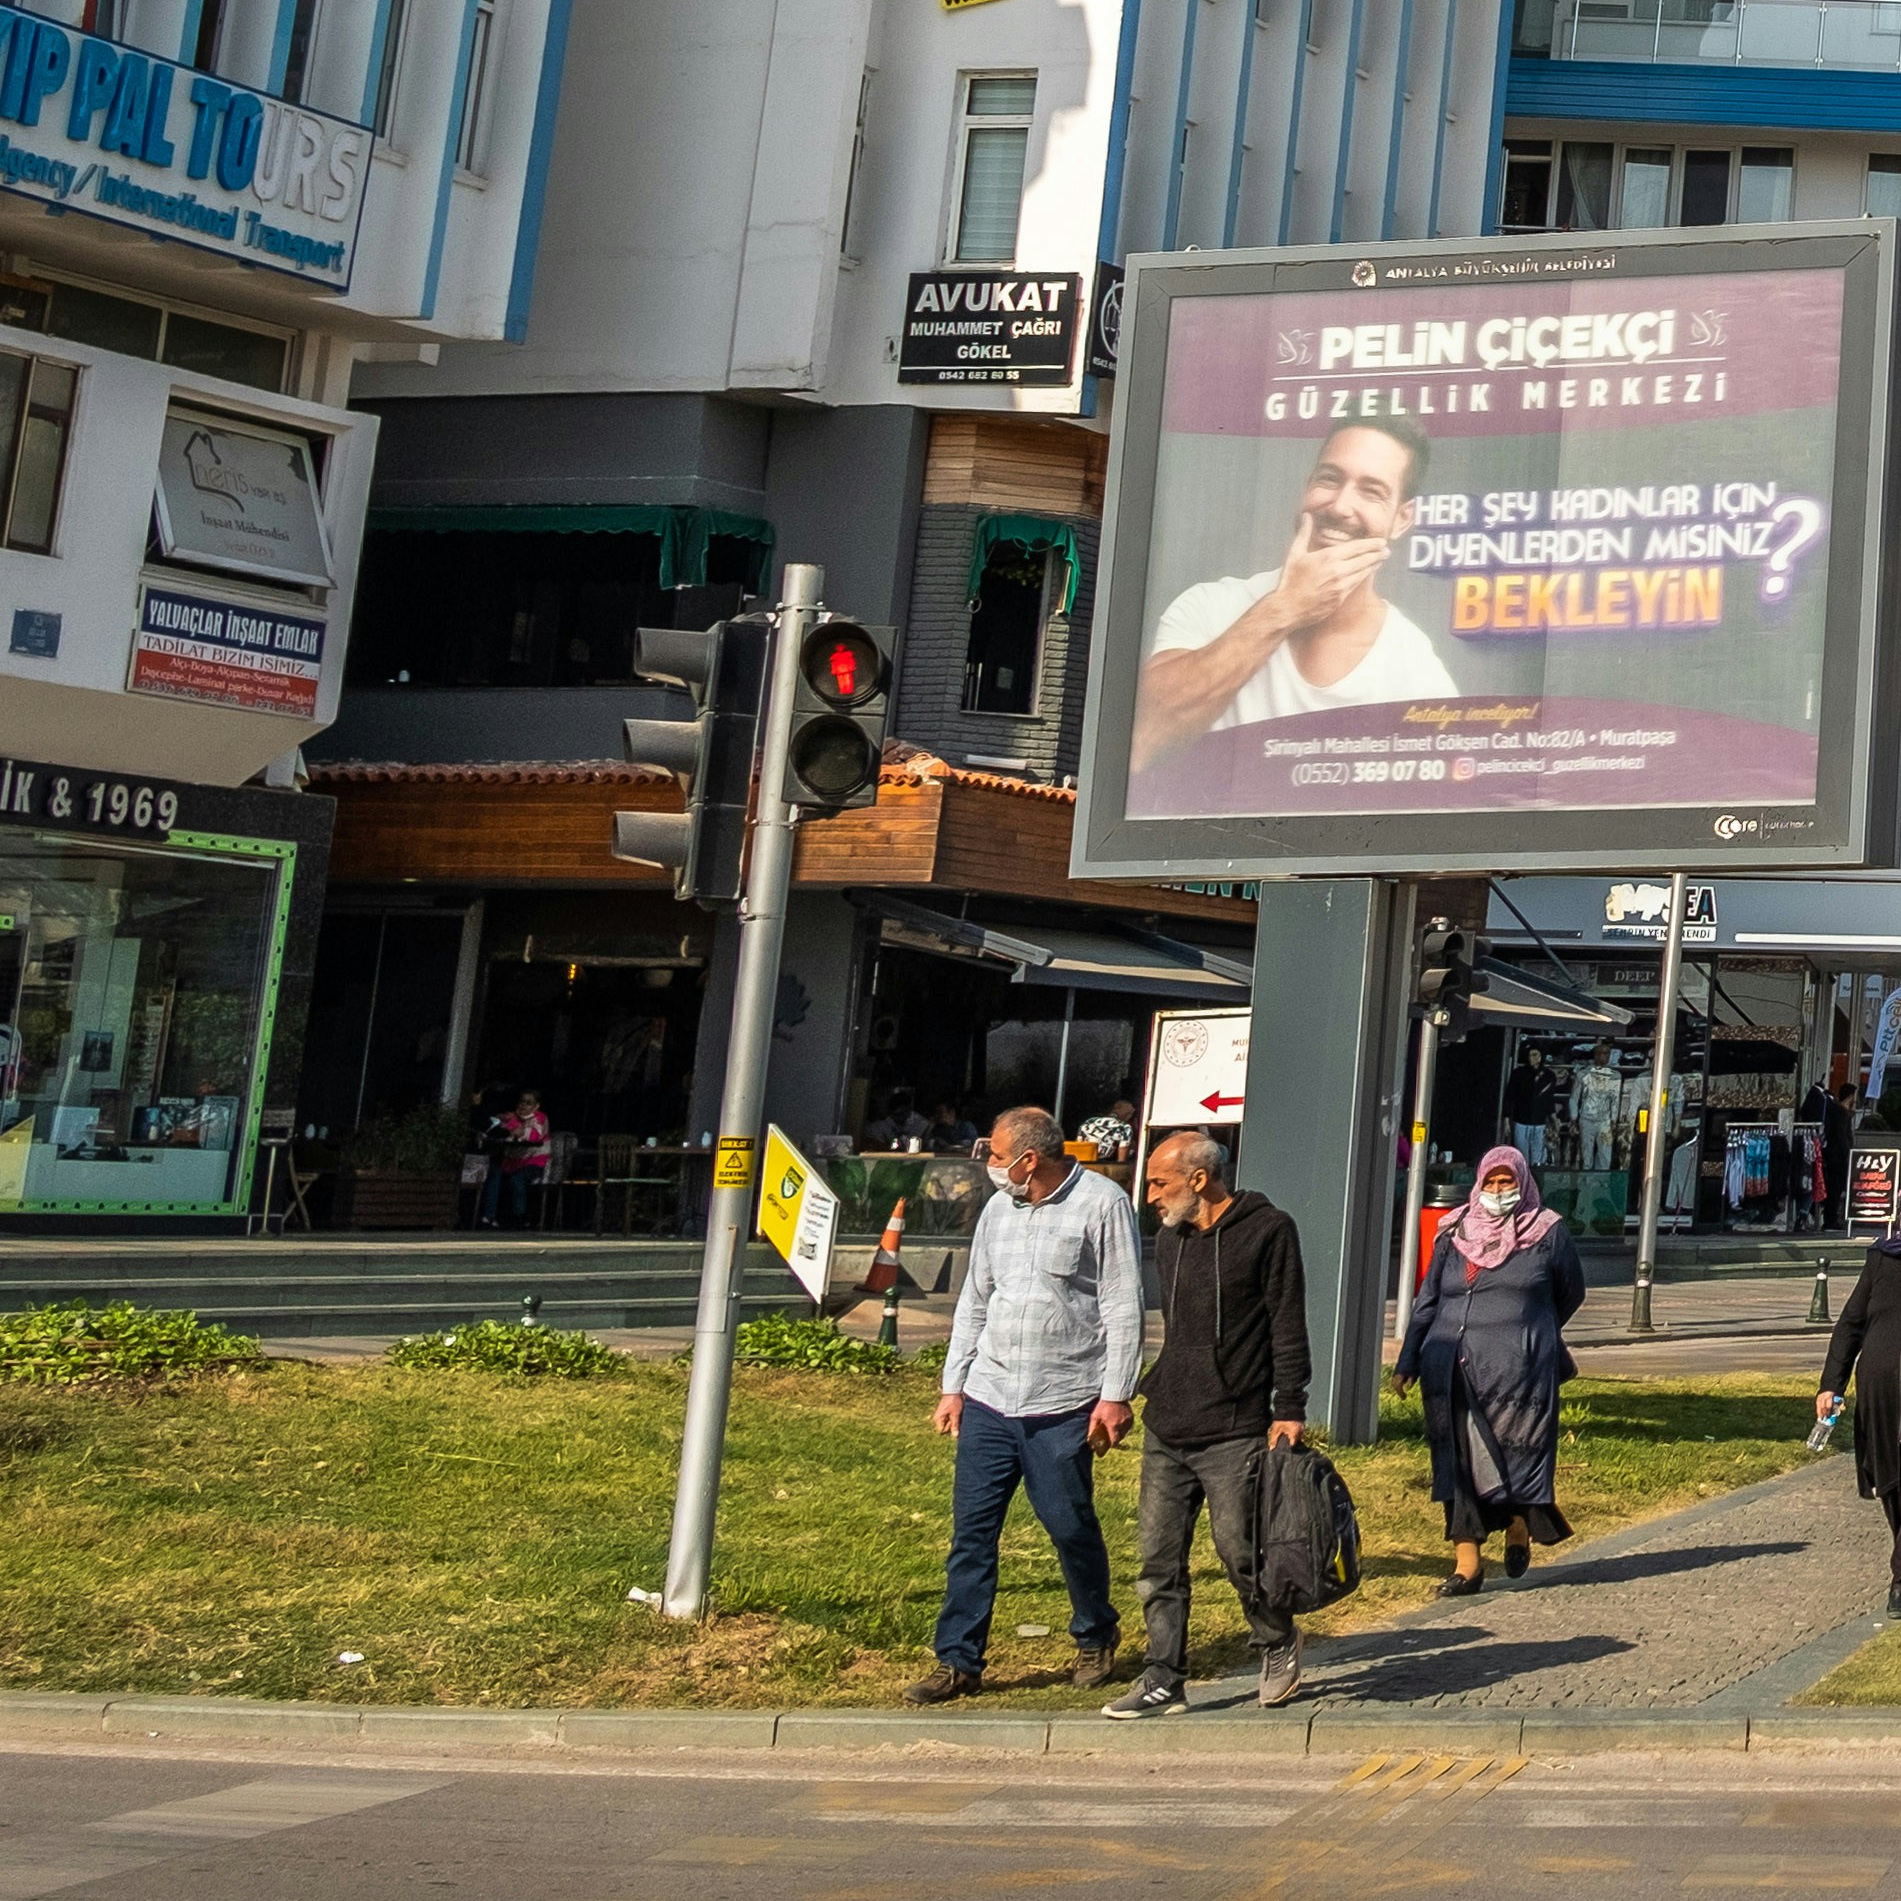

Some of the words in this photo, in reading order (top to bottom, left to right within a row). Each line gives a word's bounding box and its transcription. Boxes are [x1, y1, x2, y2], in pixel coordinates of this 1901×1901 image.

[67, 37, 176, 168] PAL
[187, 76, 364, 223] TOURS
[95, 164, 240, 241] International
[244, 210, 346, 273] Transport
[913, 281, 1068, 313] AVUKAT
[909, 321, 1004, 337] MUHAMMET
[1011, 316, 1062, 339] ÇAĞRI
[1318, 319, 1467, 371] PELİN
[1475, 308, 1677, 372] ÇİÇEKÇİ
[957, 341, 1012, 359] GÖKEL
[1264, 383, 1491, 422] GÜZELLİK
[1522, 371, 1728, 410] MERKEZİ
[1414, 493, 1469, 526] HER
[1483, 489, 1539, 529] ŞEY
[1550, 484, 1700, 521] KADINLAR
[1713, 481, 1777, 520] İÇİN
[1409, 526, 1632, 570] DİYENLERDEN
[1644, 521, 1778, 562] MİSİNİZ
[1451, 566, 1725, 633] BEKLEYİN
[143, 634, 208, 659] TADİLAT
[273, 623, 320, 656] EMLAK
[1403, 704, 1463, 731] Antalya
[1324, 735, 1390, 755] Mahallesi
[1393, 732, 1433, 752] İsmet
[1491, 731, 1523, 749] Cad.
[1526, 729, 1586, 749] No:82/A
[1600, 729, 1677, 748] Muratpaşa
[1291, 760, 1350, 787] (0552)
[1352, 761, 1389, 783] 369
[1391, 760, 1416, 781] 07
[1419, 759, 1445, 781] 80
[51, 777, 73, 818] &
[87, 782, 180, 832] 1969
